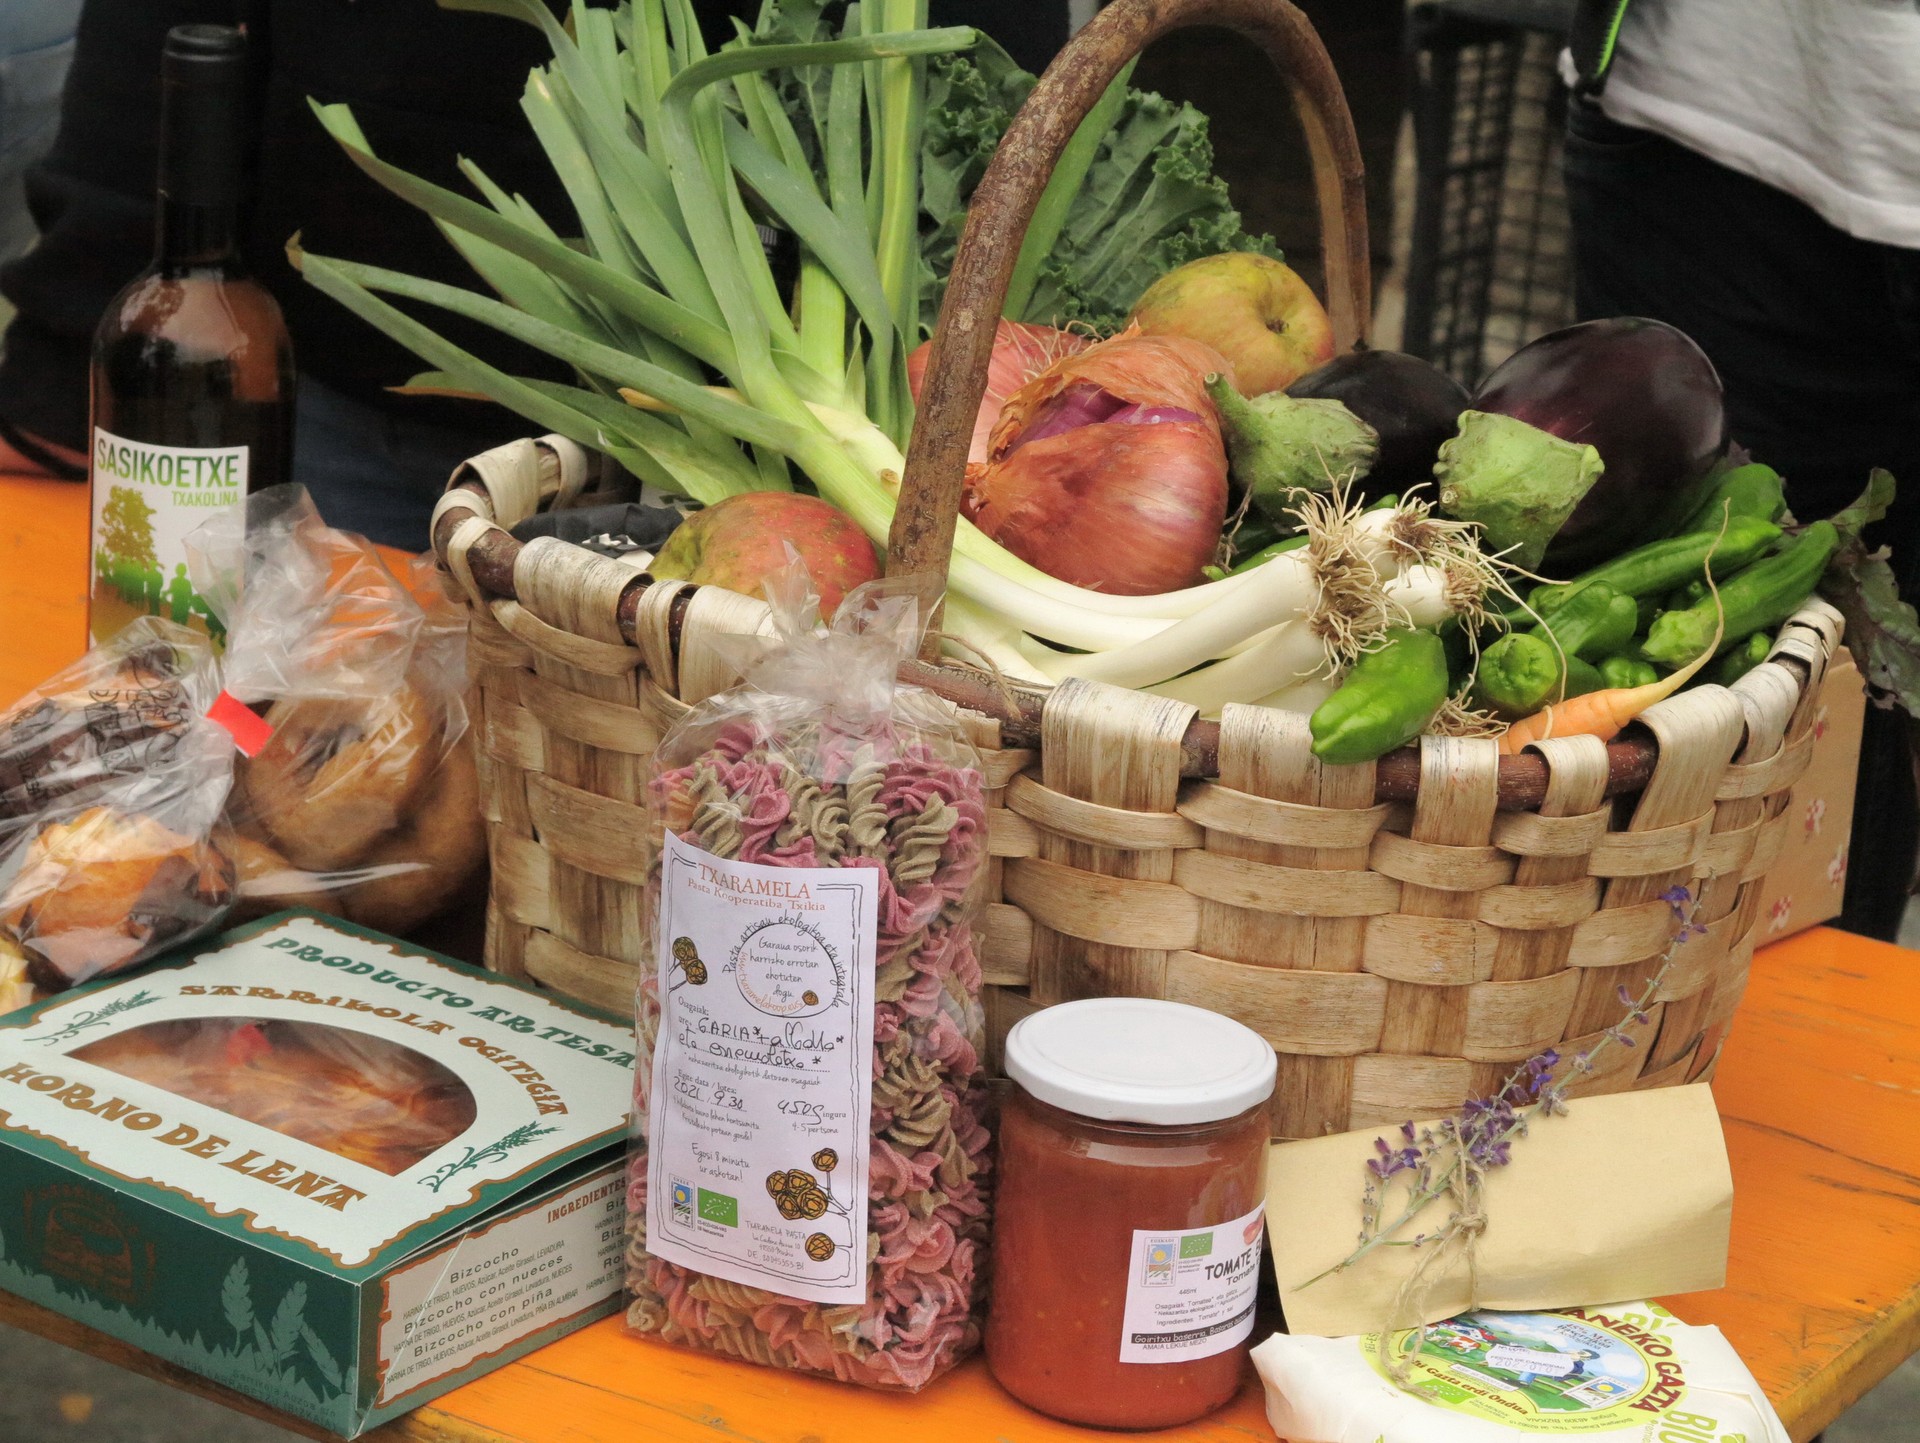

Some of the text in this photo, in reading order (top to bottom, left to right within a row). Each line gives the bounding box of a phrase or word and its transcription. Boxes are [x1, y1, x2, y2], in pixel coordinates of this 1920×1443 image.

[97, 437, 239, 488] SASIKOETXE
[172, 490, 239, 507] TXAKOLINA
[688, 877, 826, 911] Pasta Kooperatiba Txikia
[698, 863, 811, 899] TXARAMELA
[778, 909, 826, 944] ekologikoa
[749, 948, 819, 969] harrizko errotan
[759, 935, 819, 953] Garaua osorik
[825, 943, 838, 961] eta
[264, 937, 474, 1009] PRODUCTO
[722, 945, 743, 974] Pasta
[765, 967, 803, 984] ehotuten
[829, 960, 850, 1008] integrala
[678, 996, 710, 1016] Osagaiak:
[773, 984, 793, 1003] dogu
[679, 1025, 697, 1049] eta
[822, 1111, 847, 1121] inguru
[0, 1062, 368, 1212] HORNO DE LEÑA
[807, 1124, 839, 1138] pertsona
[692, 1142, 750, 1170] Egosi 8 minutu
[699, 1165, 743, 1183] ur askotan!
[547, 1177, 626, 1224] INGREDIENTES
[785, 1229, 806, 1240] PASTA
[450, 1248, 519, 1284] Bizcocho
[498, 1263, 515, 1277] Aceite
[537, 1240, 565, 1259] LEVADURA
[1205, 1247, 1252, 1281] TOMATE
[404, 1255, 563, 1334] Bizcocho con nueces
[586, 1276, 605, 1291] HARINA
[414, 1332, 422, 1343] DE
[487, 1297, 504, 1309] Aceite
[551, 1263, 573, 1280] NUECES
[414, 1288, 552, 1358] Bizcocho con piña
[386, 1370, 406, 1384] HARINA
[406, 1364, 414, 1375] DE
[548, 1298, 556, 1310] EN
[1134, 1333, 1172, 1344] Goiritxu
[1142, 1343, 1165, 1351] AMAIA
[1165, 1341, 1188, 1350] LEKUE
[1490, 1355, 1513, 1363] FECHA
[1426, 1367, 1460, 1386] Gazta
[1461, 1382, 1489, 1397] erdi
[1489, 1394, 1529, 1415] Ondua
[1629, 1361, 1686, 1413] GAZTA
